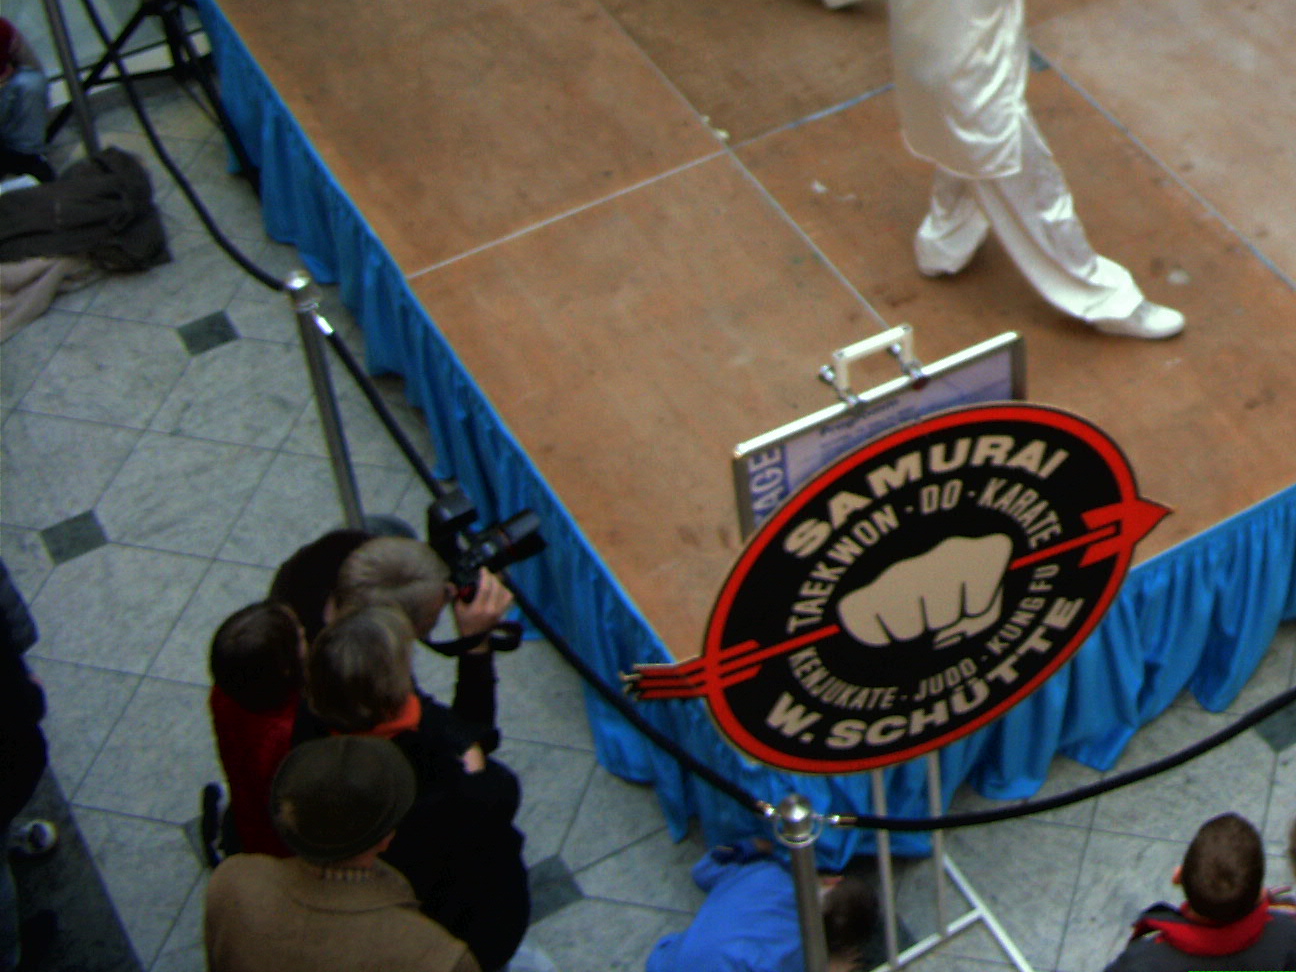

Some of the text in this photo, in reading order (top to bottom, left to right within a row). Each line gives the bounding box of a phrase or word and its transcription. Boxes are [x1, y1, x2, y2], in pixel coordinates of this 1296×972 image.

[784, 434, 1068, 558] SAMURAI
[788, 478, 1063, 633] TAEKWON DO KARATE
[766, 596, 1083, 749] W. SCHÜTTE
[789, 563, 1060, 709] KENJUKATE JUDO KUNG FU
